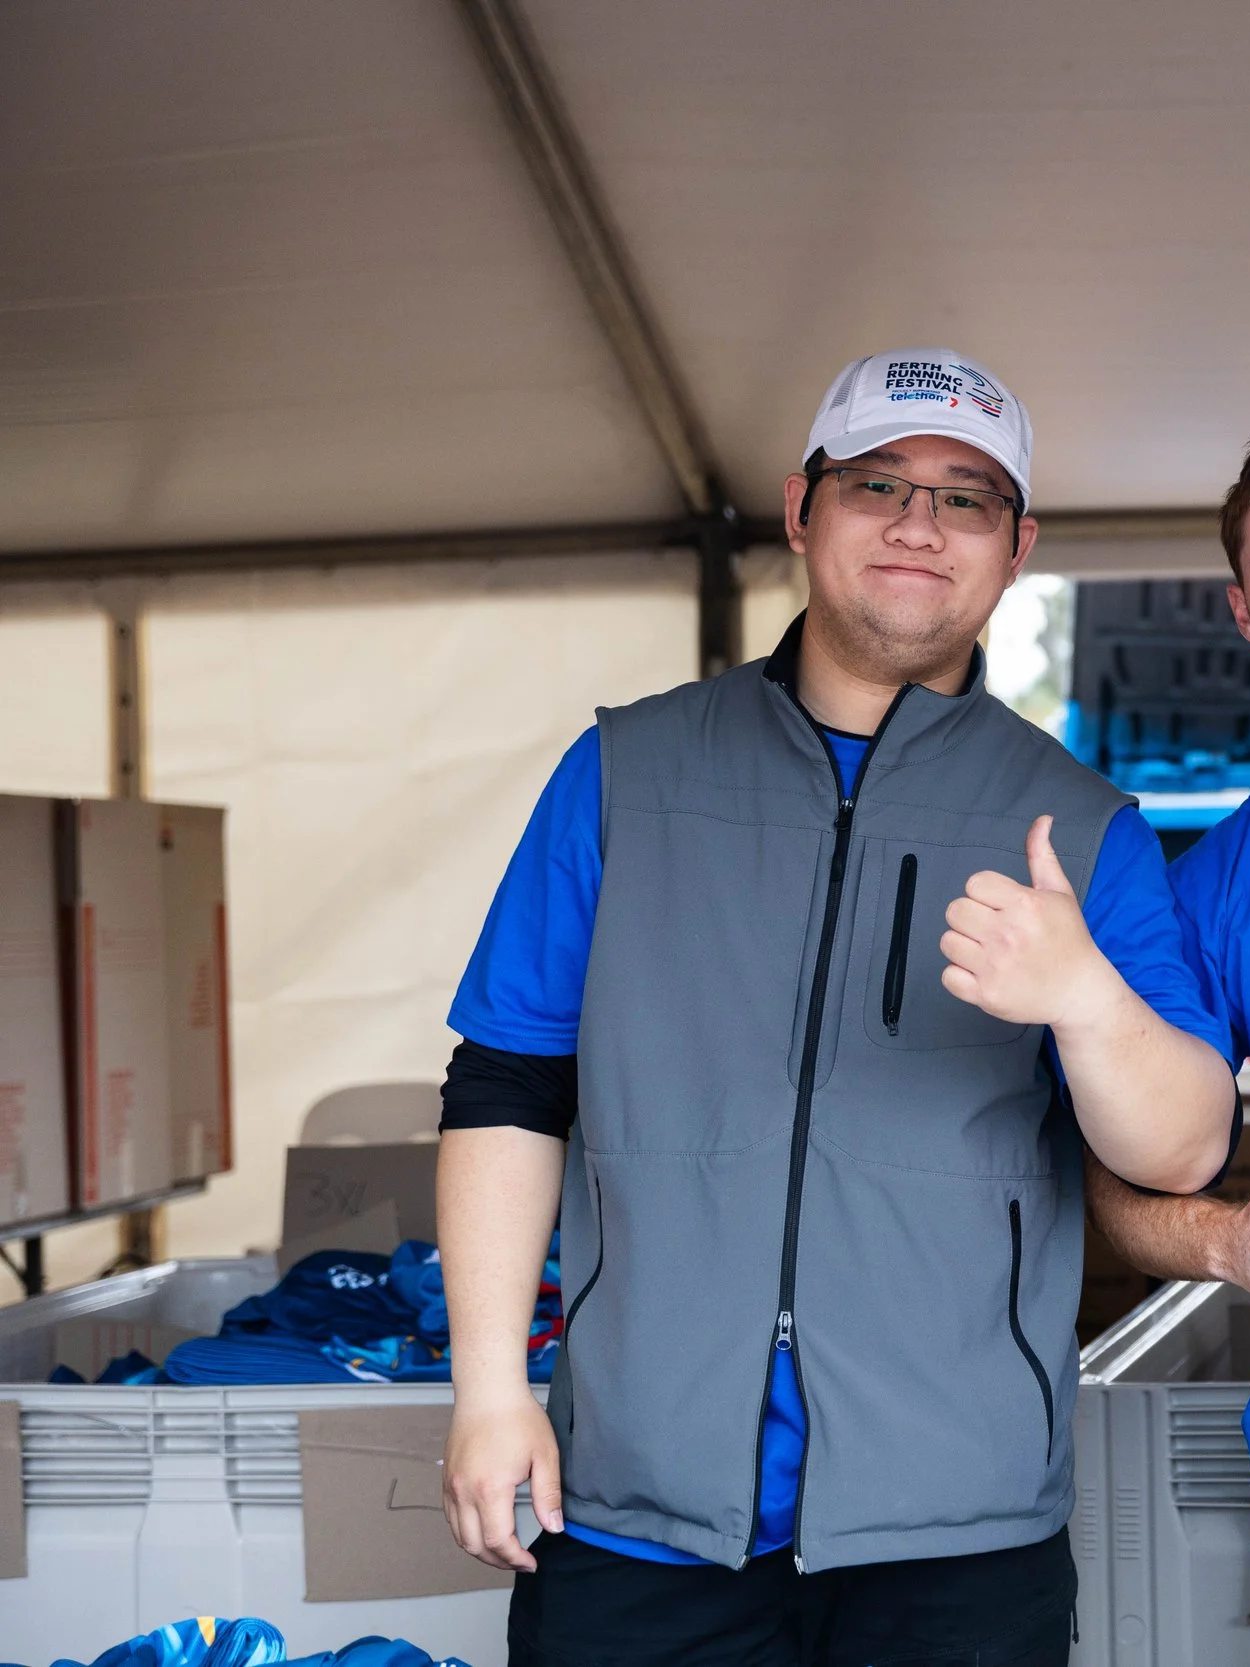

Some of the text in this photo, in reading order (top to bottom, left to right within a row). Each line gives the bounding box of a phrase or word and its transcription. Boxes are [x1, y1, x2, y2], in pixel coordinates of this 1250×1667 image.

[888, 362, 942, 371] PERTH
[887, 369, 963, 386] RUNNING
[886, 378, 961, 395] FESTIVAL
[888, 392, 948, 402] telethon
